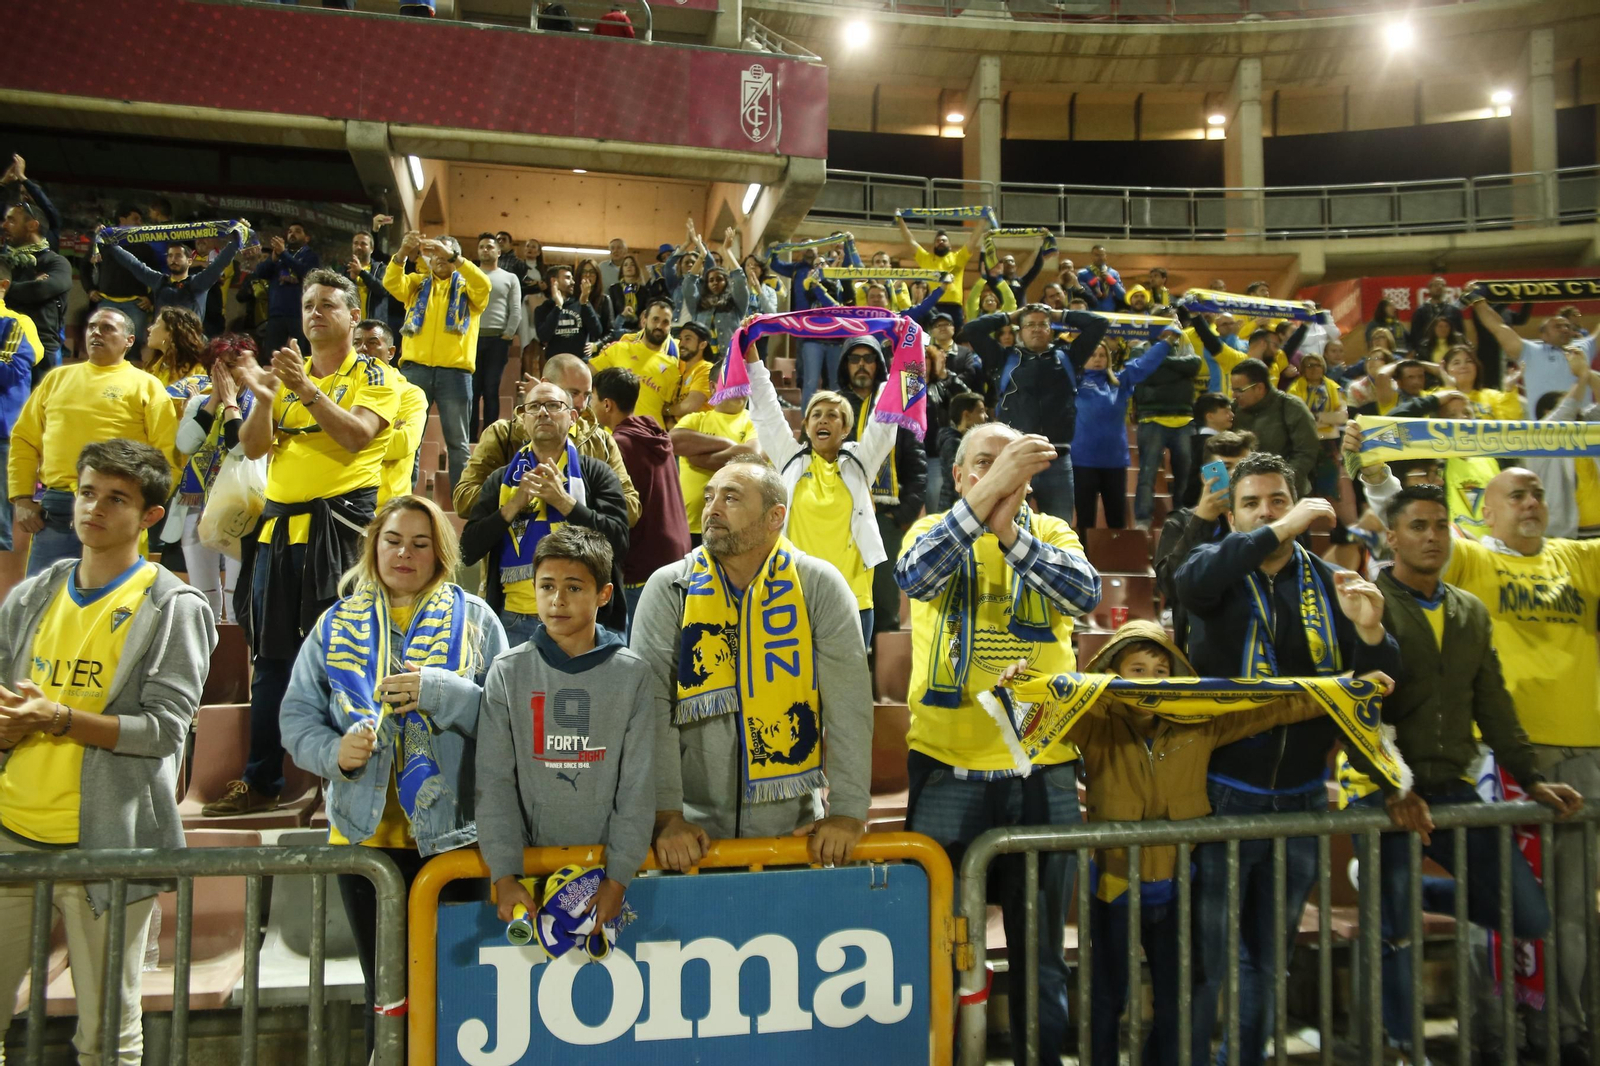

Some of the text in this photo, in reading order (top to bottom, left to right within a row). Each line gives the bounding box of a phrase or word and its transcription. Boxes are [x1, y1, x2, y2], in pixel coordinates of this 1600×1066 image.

[546, 734, 606, 751] FORTY
[579, 750, 607, 761] EIGHT
[544, 761, 563, 769] WINNER
[563, 761, 577, 769] SINCE
